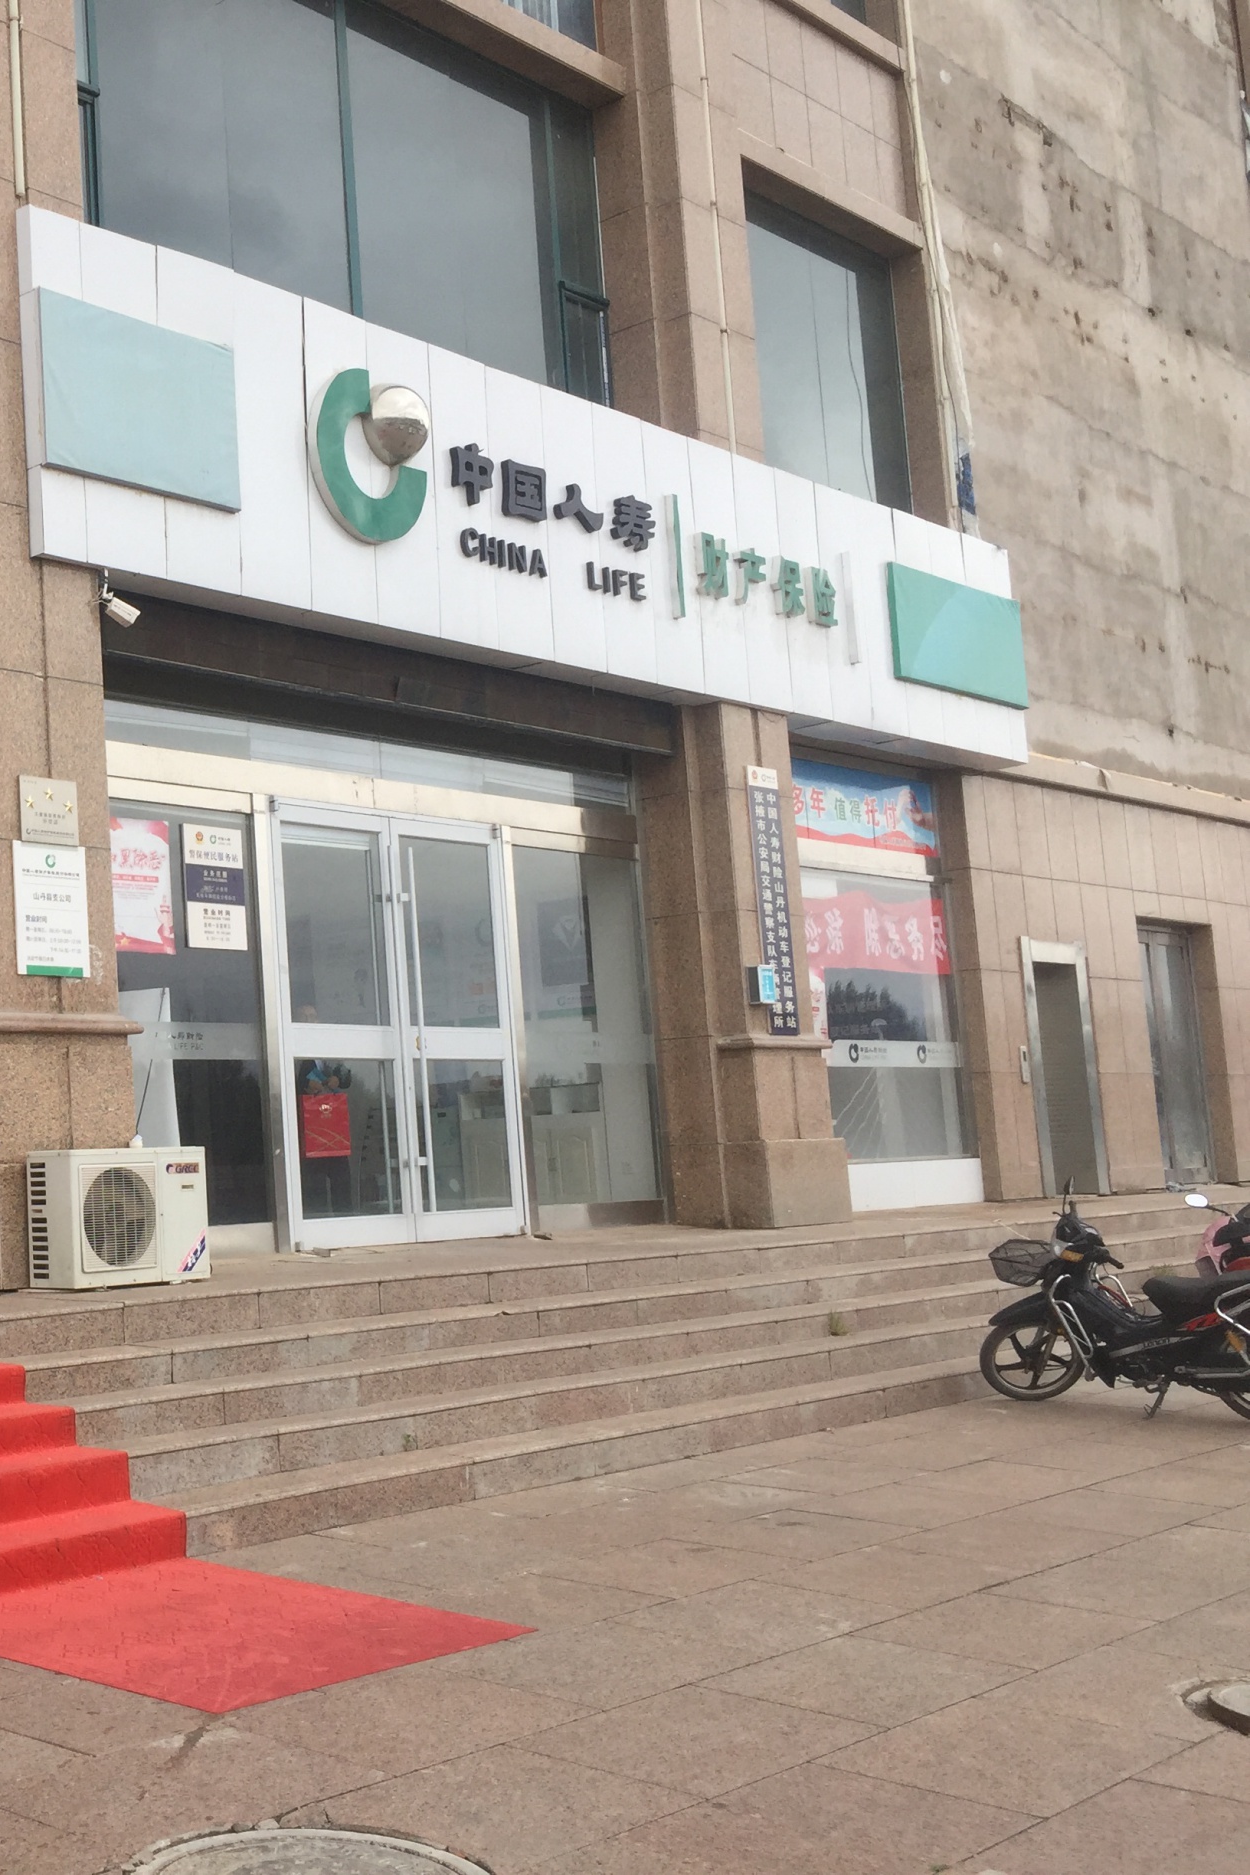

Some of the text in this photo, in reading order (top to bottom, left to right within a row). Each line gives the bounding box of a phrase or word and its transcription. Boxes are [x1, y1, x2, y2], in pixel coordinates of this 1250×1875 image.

[449, 442, 656, 552] 中国人寿
[460, 527, 647, 601] CHINA LIFE
[693, 531, 839, 628] 财产保险
[834, 795, 897, 830] 值得托付
